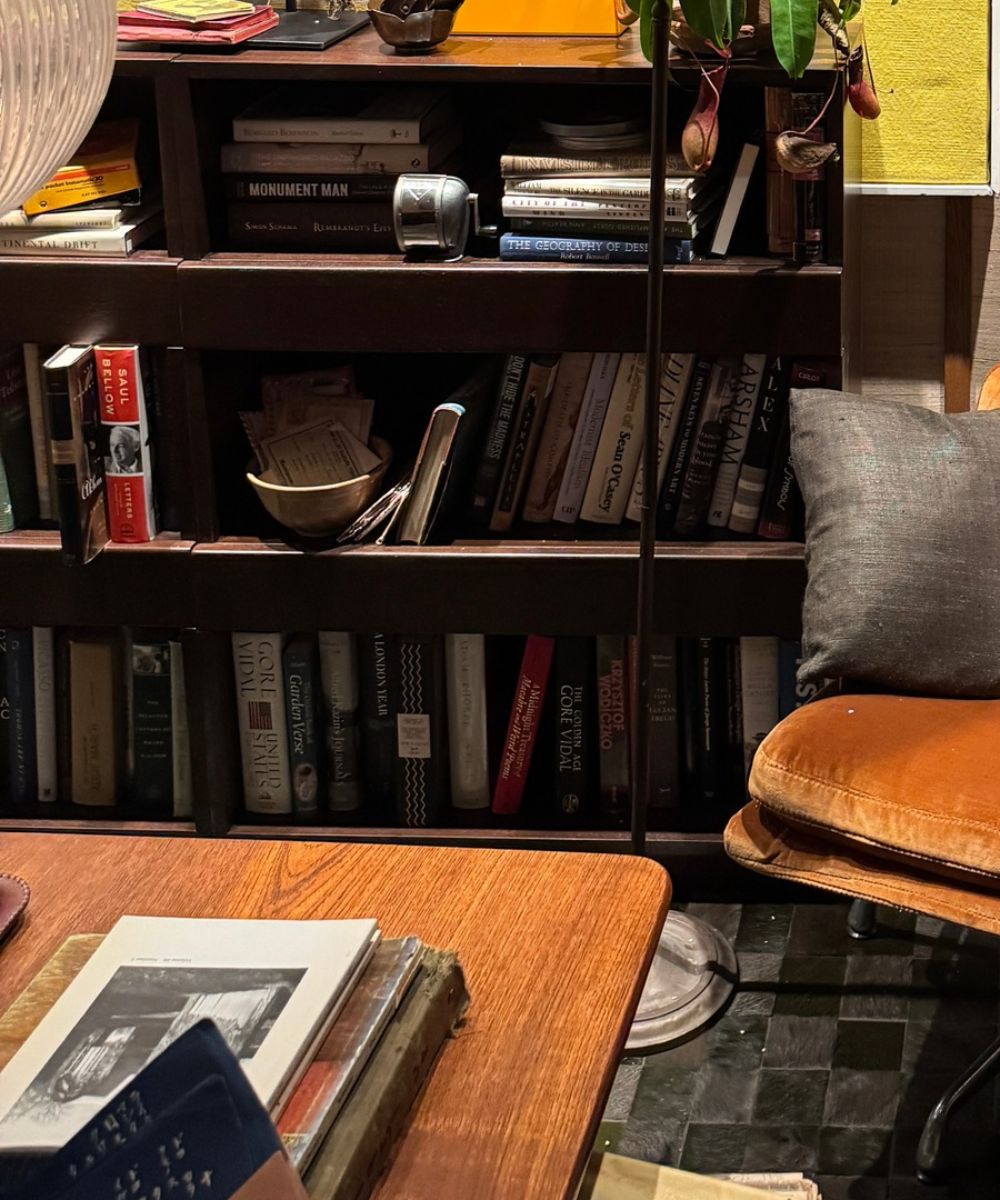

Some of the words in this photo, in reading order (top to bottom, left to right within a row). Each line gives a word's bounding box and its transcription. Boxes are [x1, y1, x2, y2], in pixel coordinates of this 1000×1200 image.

[519, 158, 614, 170] INVISIBLE
[250, 182, 319, 197] MONUMENT
[321, 182, 349, 197] MAN
[562, 188, 599, 196] SILENCE
[64, 240, 98, 250] DRIFT
[508, 240, 531, 250] THE
[535, 241, 603, 251] GEOGRAPHY
[606, 243, 621, 251] OF
[102, 358, 114, 415] BELLOW
[118, 368, 130, 405] SAUL
[509, 356, 526, 381] DON'T
[503, 382, 520, 401] HIDE
[624, 368, 644, 413] Letters
[757, 356, 782, 432] ALEX
[500, 402, 515, 419] THE
[584, 400, 605, 448] Modernist
[621, 413, 634, 431] of
[719, 362, 759, 464] ARSHAM
[488, 420, 510, 460] MADNESS
[613, 431, 631, 462] Sean
[574, 450, 592, 490] Idealism
[599, 464, 623, 513] O'Casey
[668, 476, 679, 495] ART
[124, 482, 133, 519] LETTERS
[238, 641, 257, 698] VIDAL
[257, 641, 277, 699] GORE
[374, 641, 386, 687] LONDON
[289, 674, 305, 721] Garden
[377, 688, 389, 716] YEAR
[516, 674, 532, 713] Macabre
[521, 689, 541, 732] Midnight
[559, 684, 574, 724] GORE
[573, 685, 584, 704] THE
[599, 674, 612, 750] WODICZKO
[611, 659, 624, 732] KRZYSZTOF
[330, 701, 345, 735] Kazin's
[572, 709, 583, 748] GOLDEN
[293, 723, 305, 755] Verse
[559, 729, 573, 772] VIDAL
[252, 733, 268, 787] STATES
[265, 733, 281, 790] UNITED
[501, 752, 515, 782] Poems
[572, 754, 582, 772] AGE
